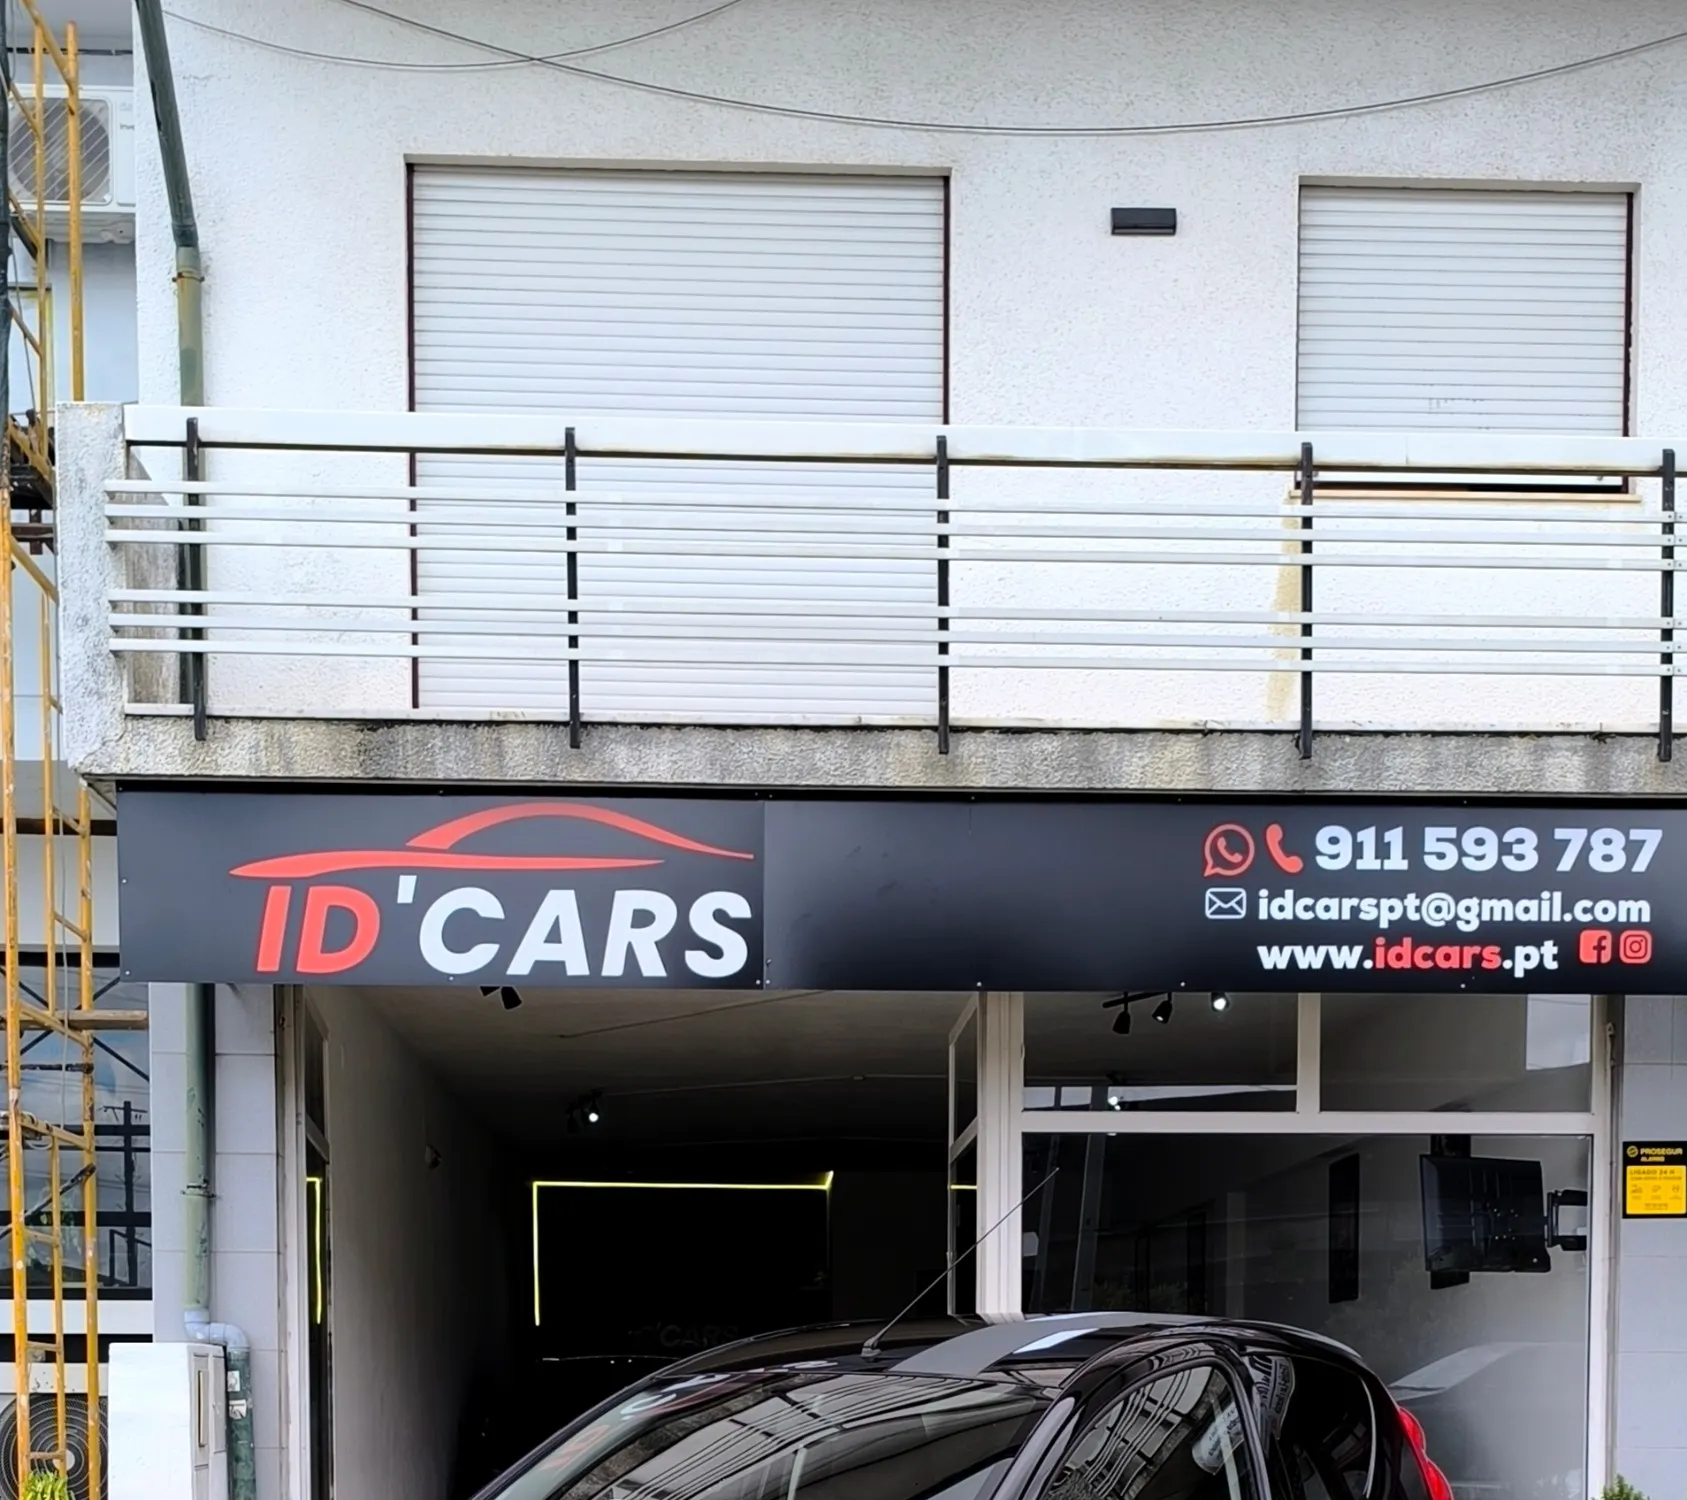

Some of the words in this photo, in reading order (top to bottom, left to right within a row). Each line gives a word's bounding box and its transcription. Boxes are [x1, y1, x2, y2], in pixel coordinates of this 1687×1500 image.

[1314, 825, 1409, 872] 911
[1423, 826, 1540, 873] 593
[1553, 828, 1663, 873] 787
[256, 874, 753, 978] ID'CARS
[1257, 889, 1652, 932] idcarspt@gmail.com
[1256, 937, 1559, 978] www.idcars.pt
[1640, 1147, 1683, 1156] PROSEGUR
